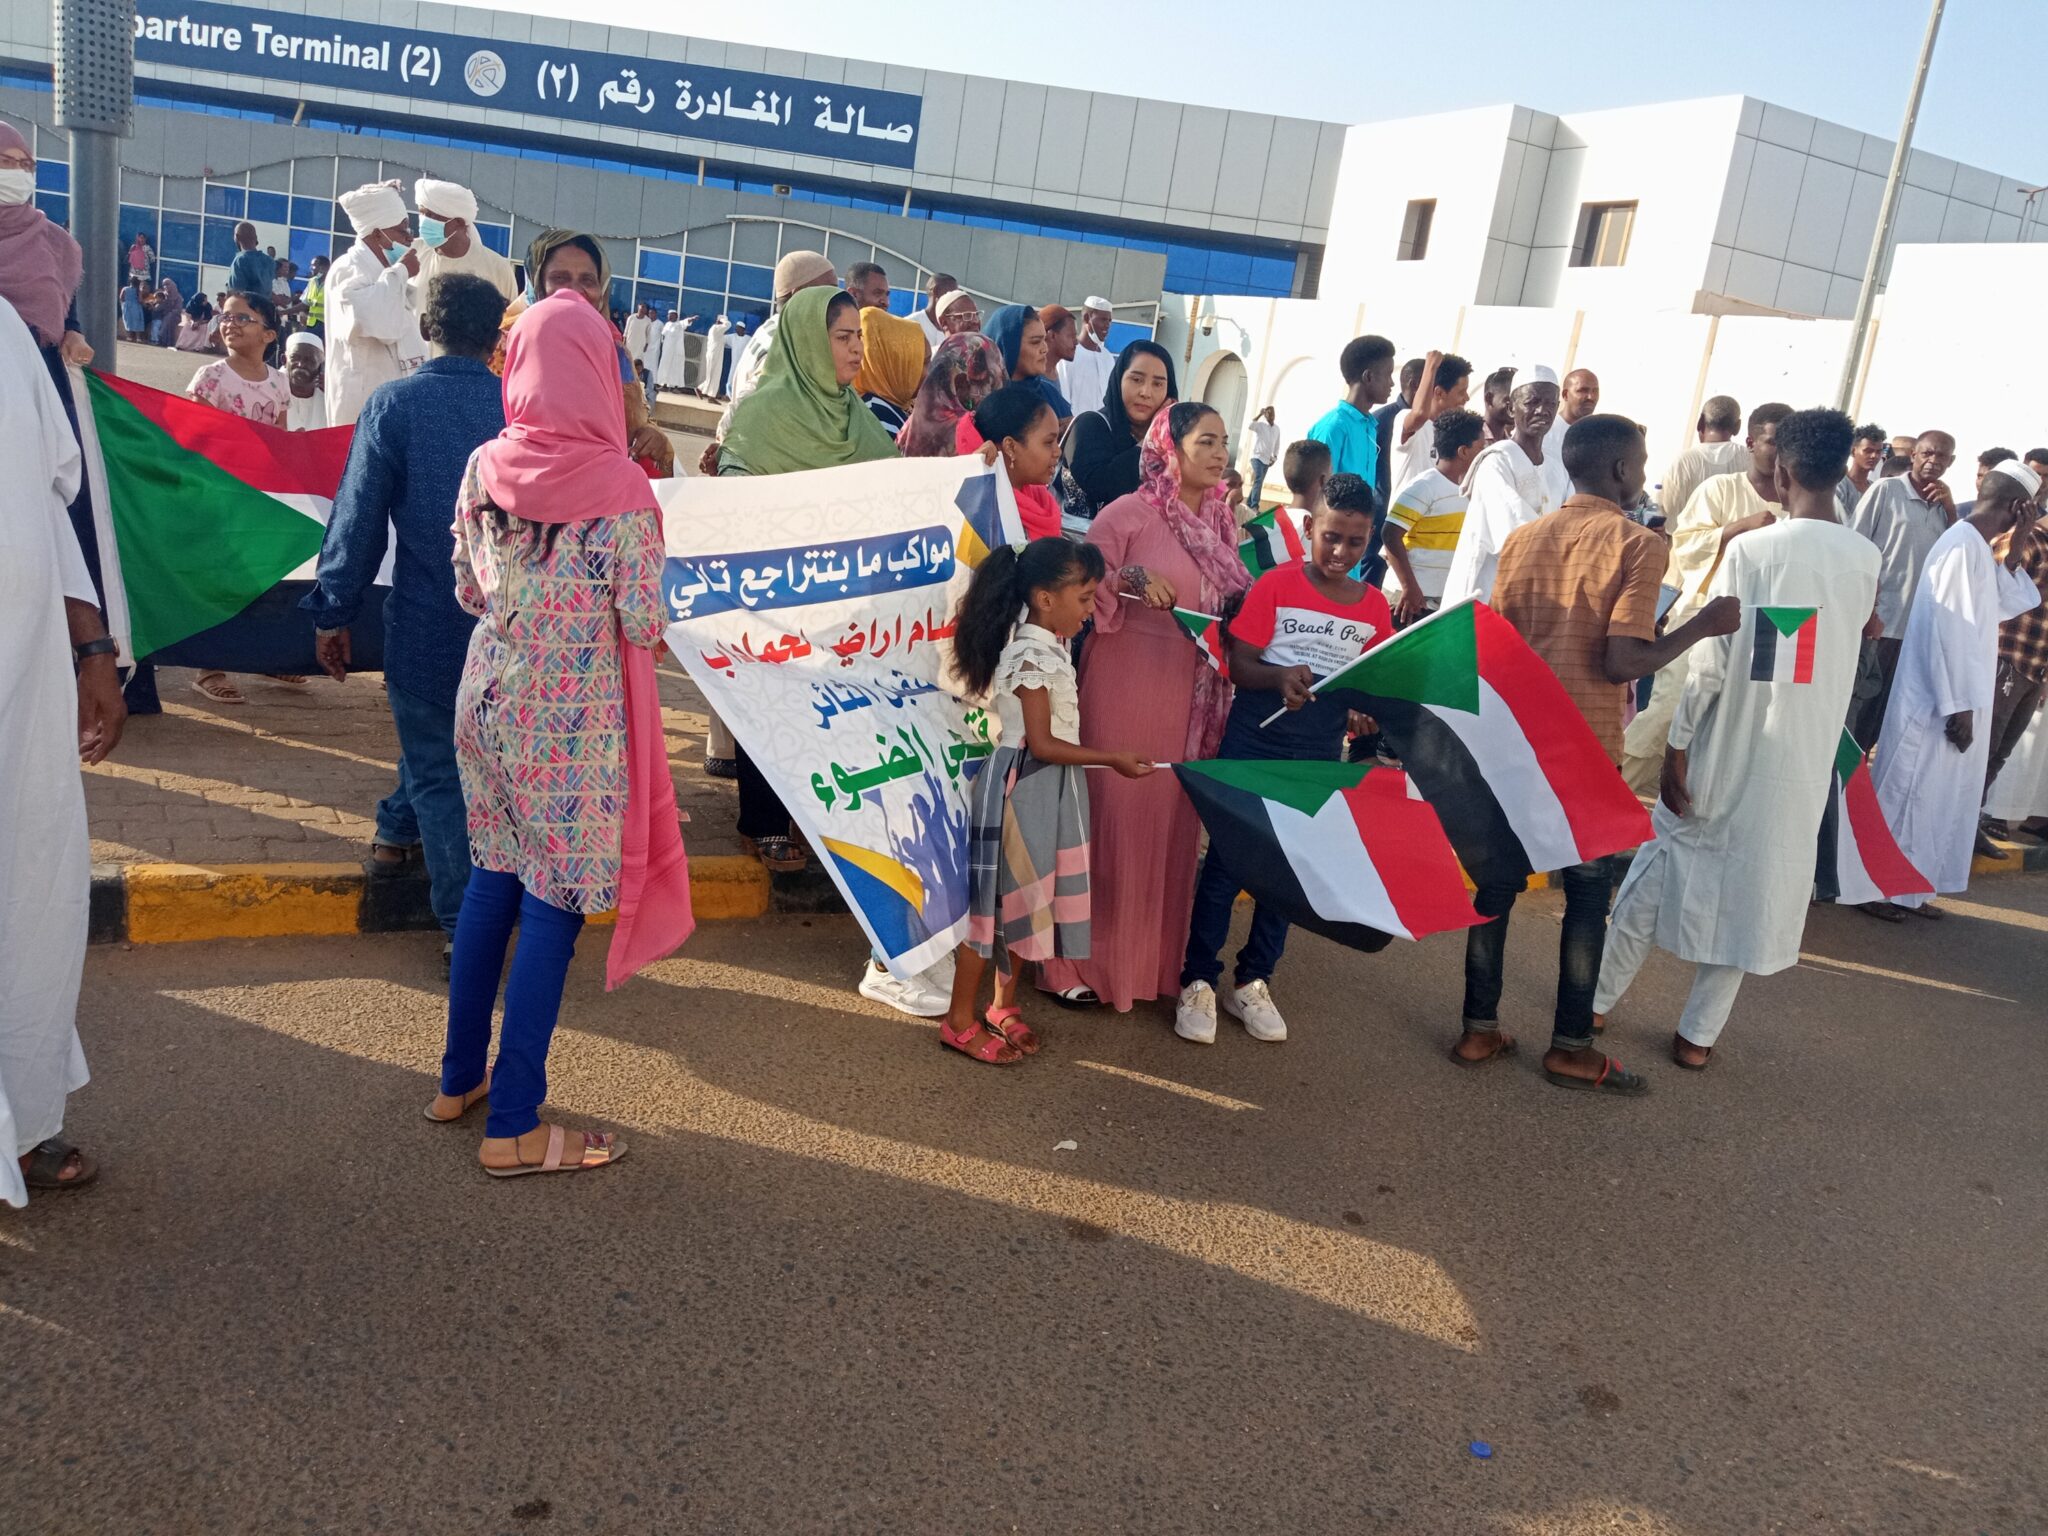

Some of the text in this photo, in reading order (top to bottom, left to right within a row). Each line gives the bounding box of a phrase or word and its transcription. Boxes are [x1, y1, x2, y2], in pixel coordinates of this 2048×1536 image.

[134, 15, 442, 86] parture Terminal (2)
[537, 60, 914, 144] صالة المغادرة رقم (٢)
[669, 534, 951, 619] مواكب ما بتتراجع تاني
[831, 613, 902, 668] اراضي
[1281, 618, 1334, 637] Beach
[810, 721, 935, 814] الضوء
